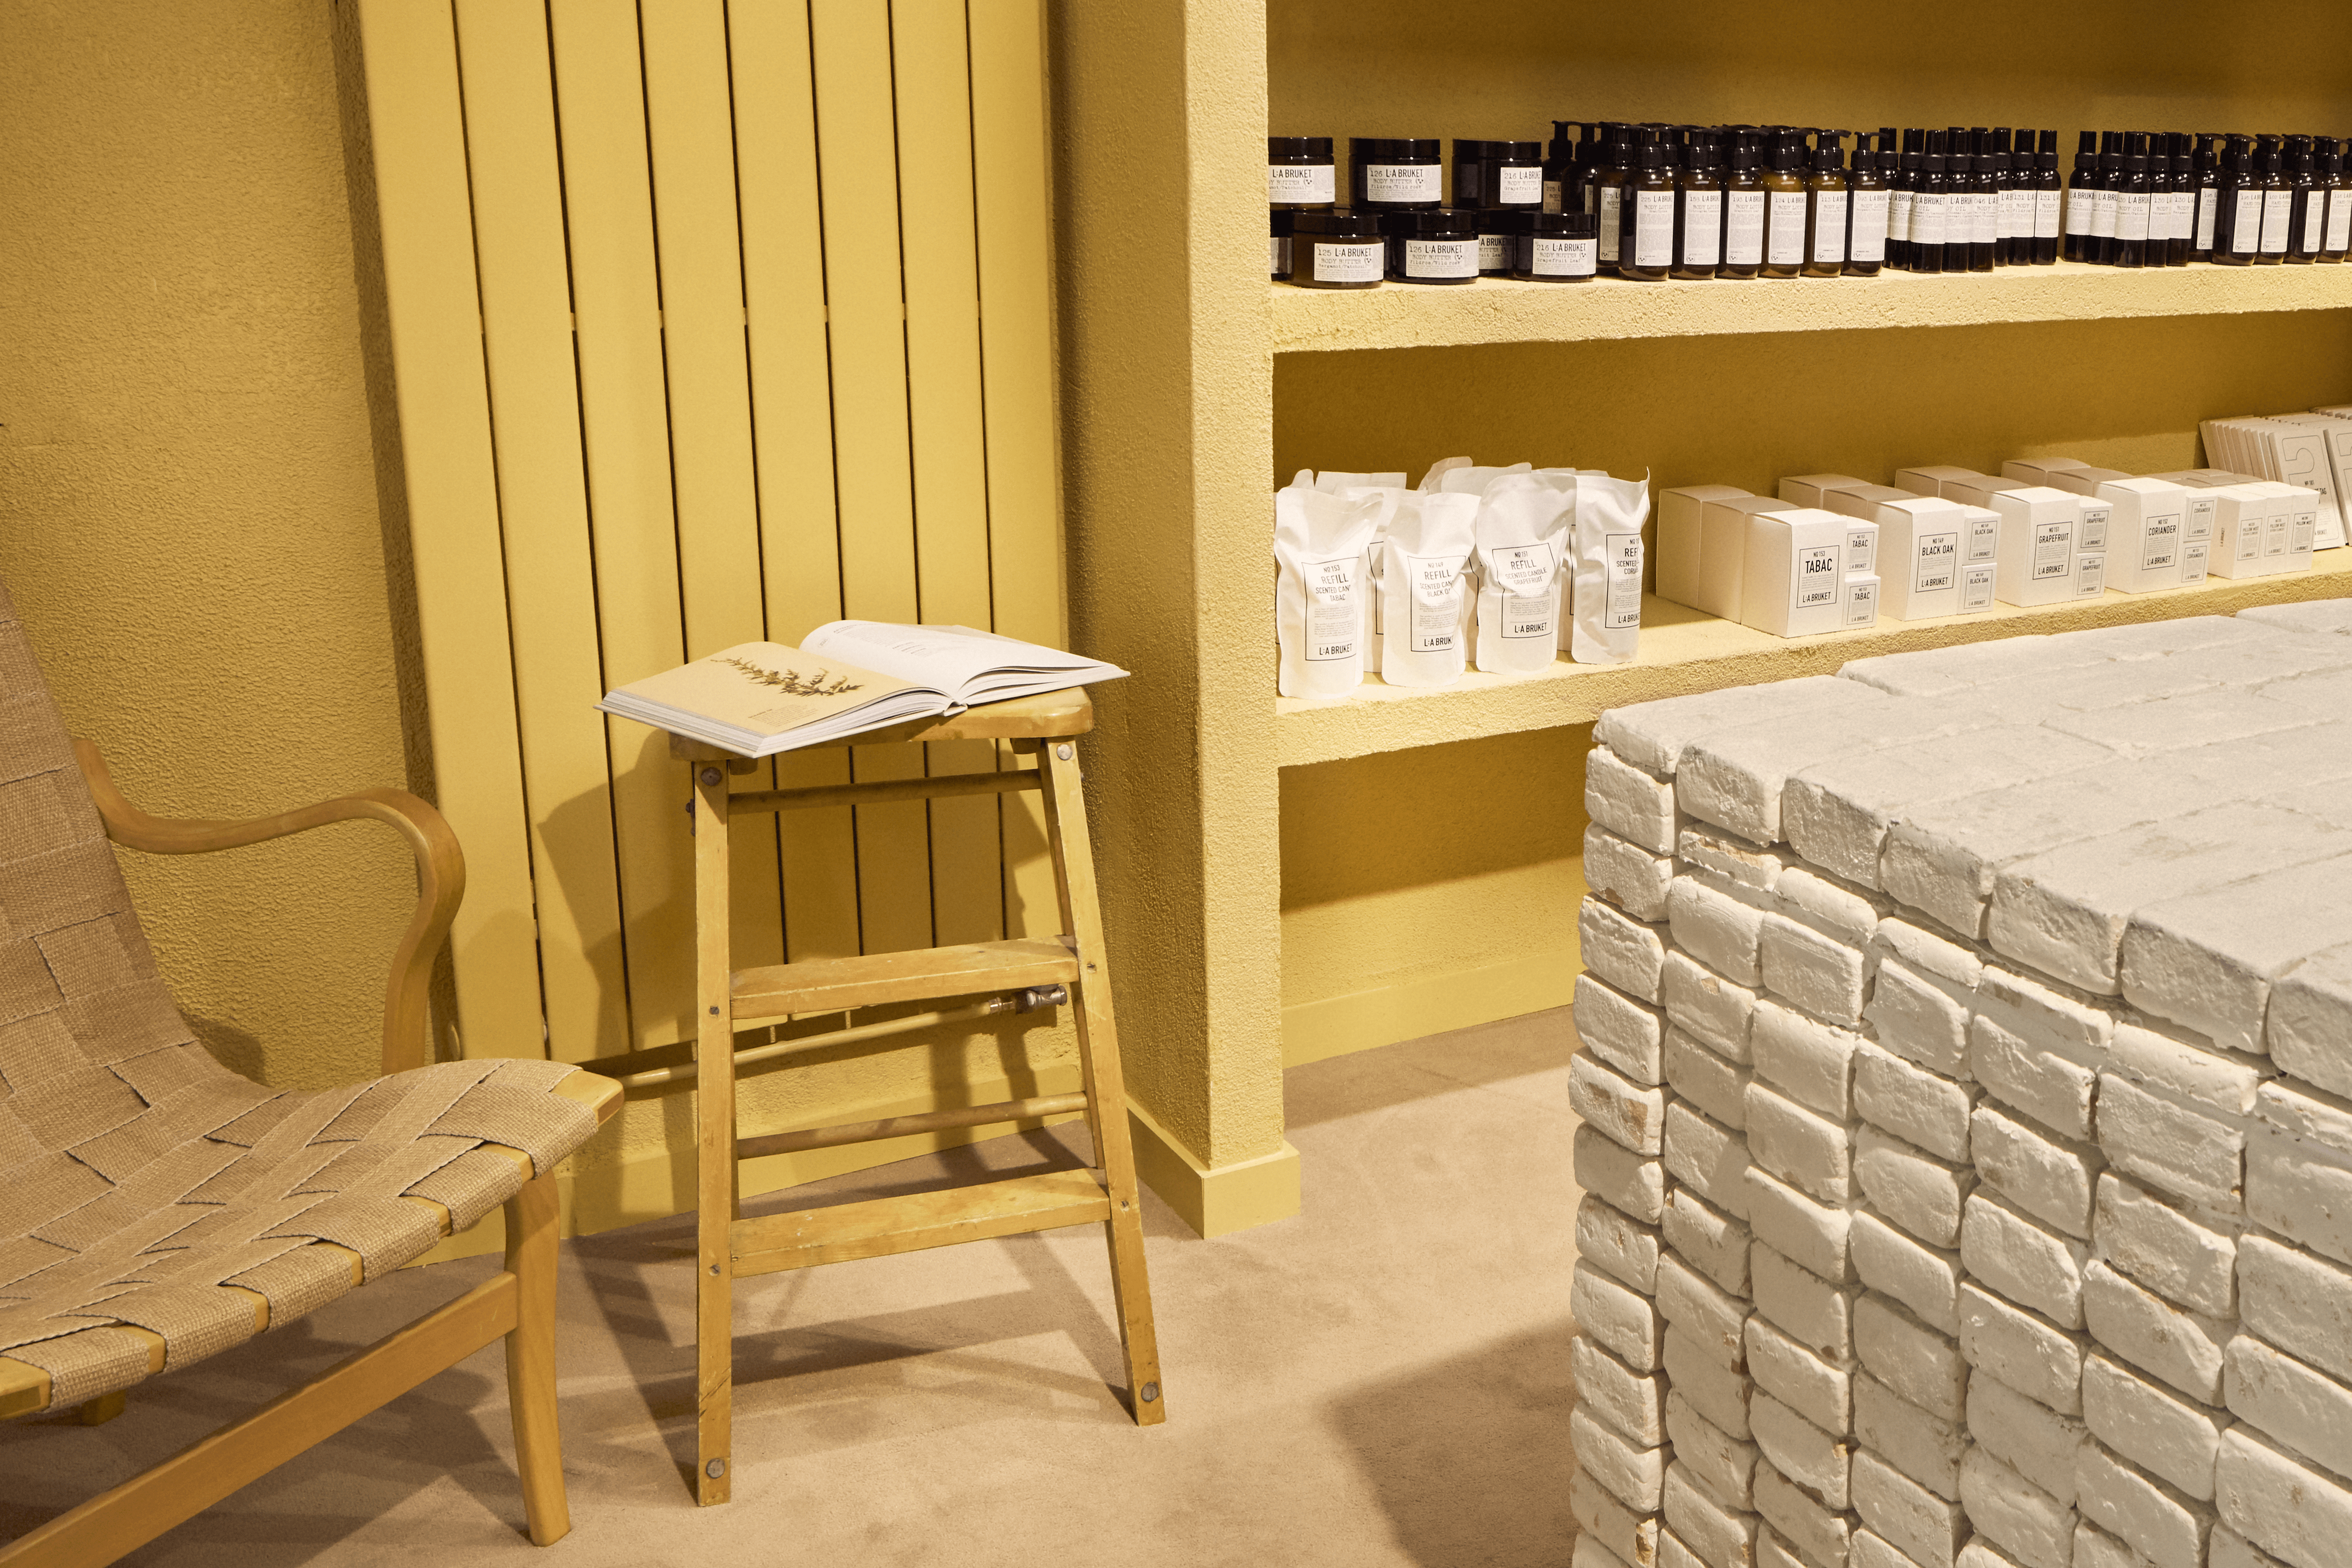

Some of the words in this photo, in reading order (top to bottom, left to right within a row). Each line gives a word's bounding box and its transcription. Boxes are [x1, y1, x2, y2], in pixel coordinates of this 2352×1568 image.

[1286, 169, 1312, 178] BRUKET
[1336, 248, 1346, 256] L:A
[1348, 248, 1371, 256] BRUKET
[2148, 525, 2176, 536] CORIANDER
[1852, 539, 1868, 548] TABAC
[2039, 533, 2068, 544] GRAPEFRUIT
[1625, 548, 1637, 557] REF
[1922, 546, 1940, 556] BLACK
[1942, 544, 1954, 553] OAK
[1511, 559, 1536, 570] REFILL
[2154, 555, 2170, 564] BRUKET
[1806, 558, 1832, 573] TABAC
[2046, 564, 2064, 574] BRUKET
[1424, 570, 1452, 580] REFILL
[1528, 567, 1547, 576] CANDLE
[1321, 573, 1348, 584] REFILL
[1514, 576, 1542, 585] GRAPEFRUIT
[1930, 577, 1948, 586] BRUKET
[1812, 591, 1830, 601] BRUKET
[1855, 592, 1870, 600] TABAC
[1526, 622, 1547, 632] BRUKET
[1436, 636, 1452, 646] BRUK
[1332, 643, 1352, 654] BRUKET
